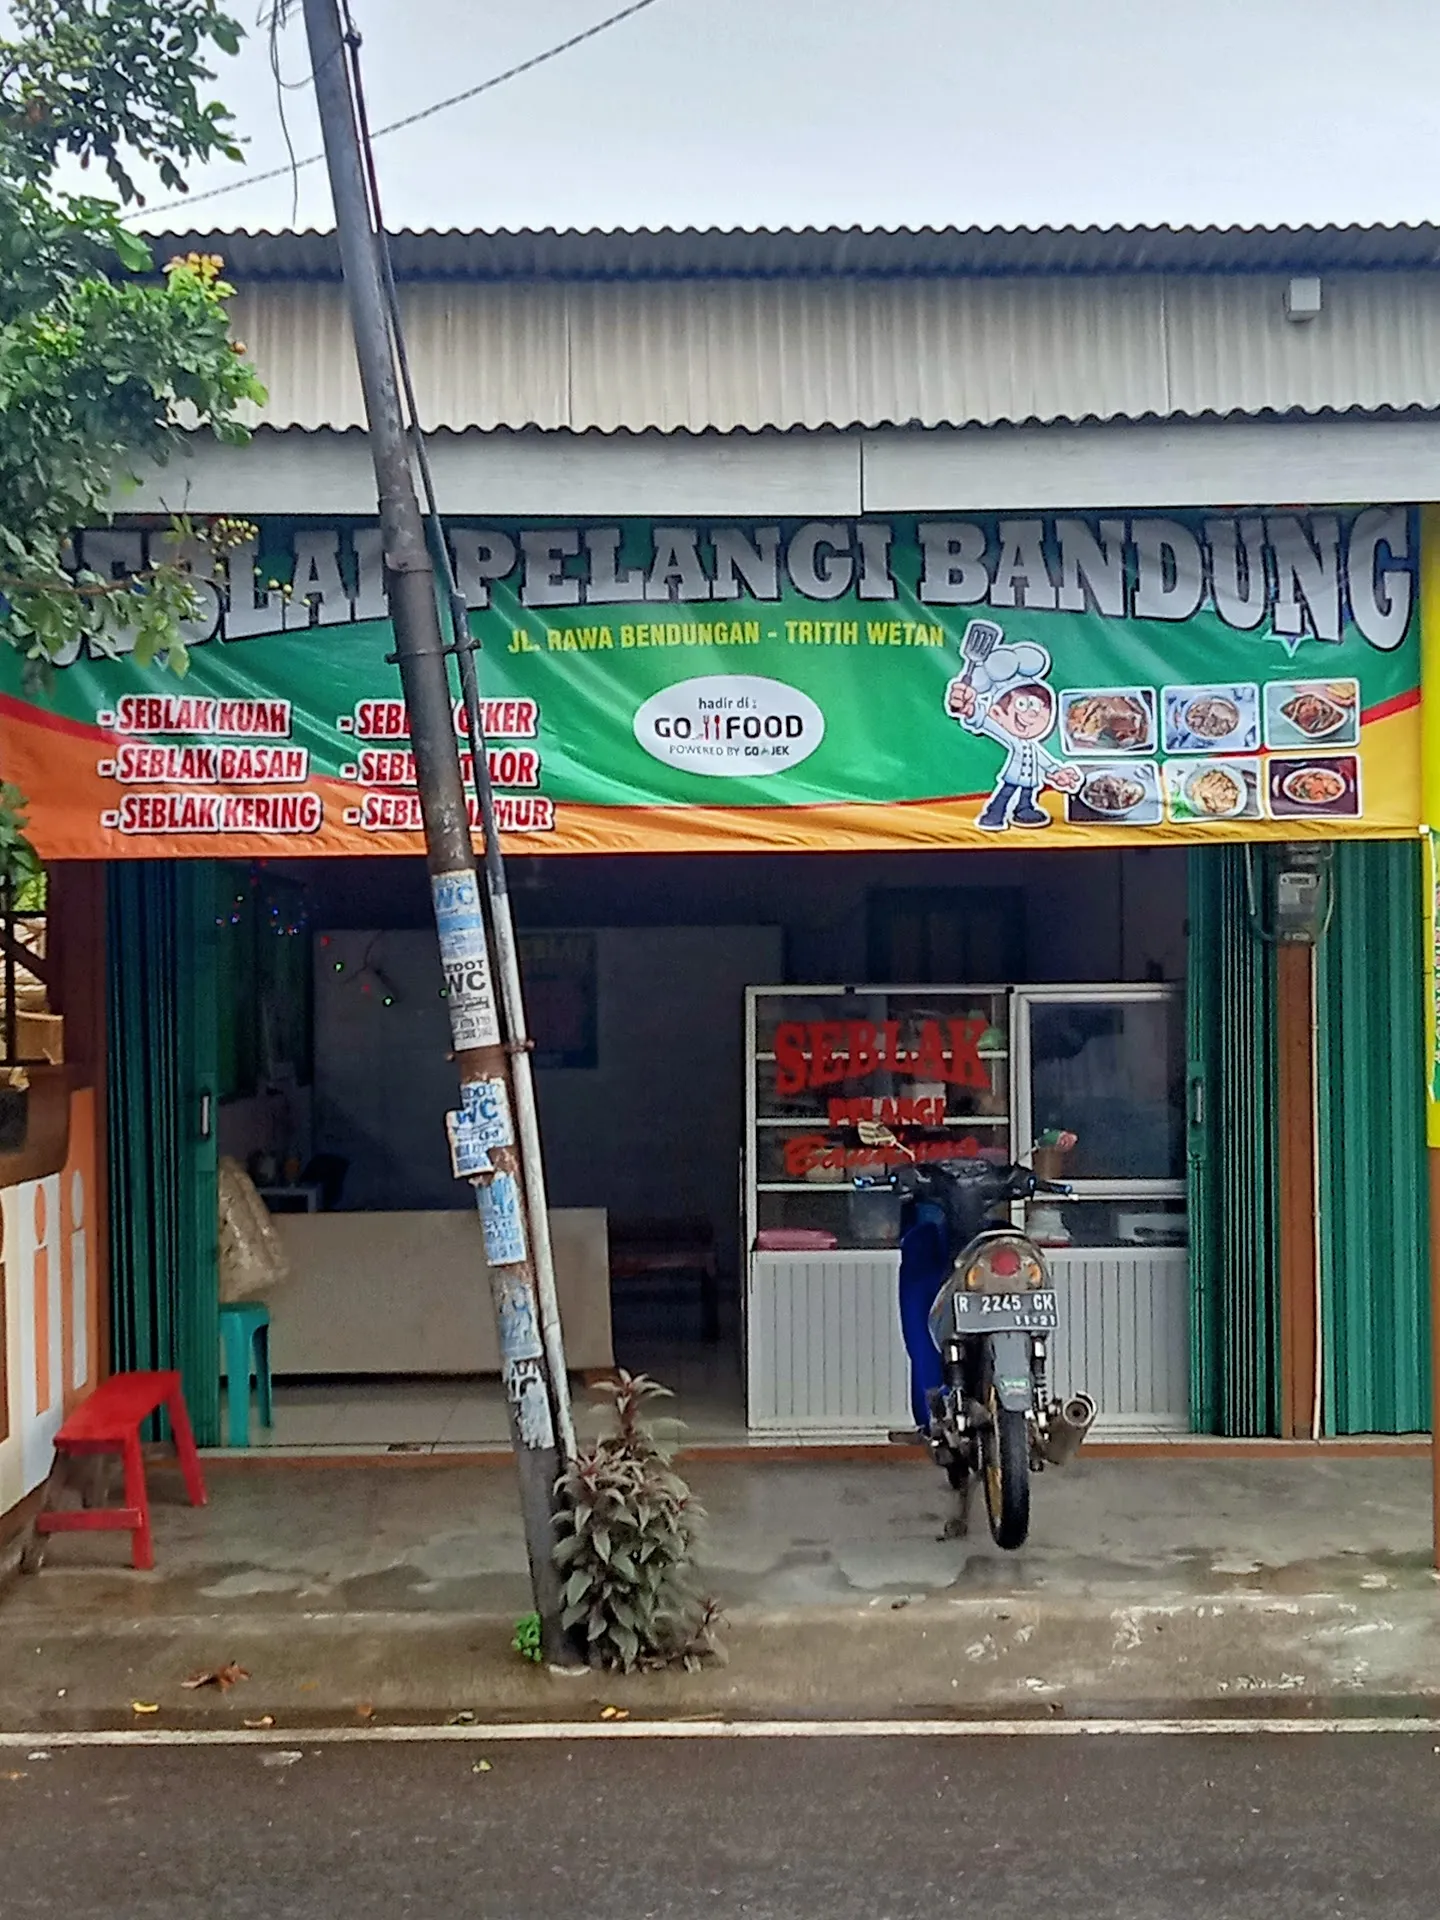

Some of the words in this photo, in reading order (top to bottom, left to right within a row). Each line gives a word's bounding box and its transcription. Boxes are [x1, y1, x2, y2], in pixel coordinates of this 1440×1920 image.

[449, 522, 898, 607] PELANGI
[916, 507, 1413, 652] BANDUNG
[507, 629, 541, 654] JL.
[547, 626, 614, 651] RAWA
[620, 620, 760, 648] BENDUNGAN
[785, 620, 859, 645] TRITIH
[866, 622, 945, 648] WETAN
[119, 697, 214, 730] SEBLAK
[219, 702, 287, 733] KUAH
[698, 697, 733, 710] hadir
[726, 714, 804, 740] FOOD
[119, 748, 214, 779] SEBLAK
[219, 749, 303, 779] BASAH
[669, 745, 724, 756] POWERED
[726, 746, 740, 756] BY
[460, 750, 536, 784] TLOR
[122, 797, 215, 828] SEBLAK
[222, 797, 318, 828] KERING
[444, 971, 486, 994] WC
[775, 1018, 991, 1095] SEBLAK
[959, 1297, 969, 1313] R
[981, 1295, 1021, 1312] 2245
